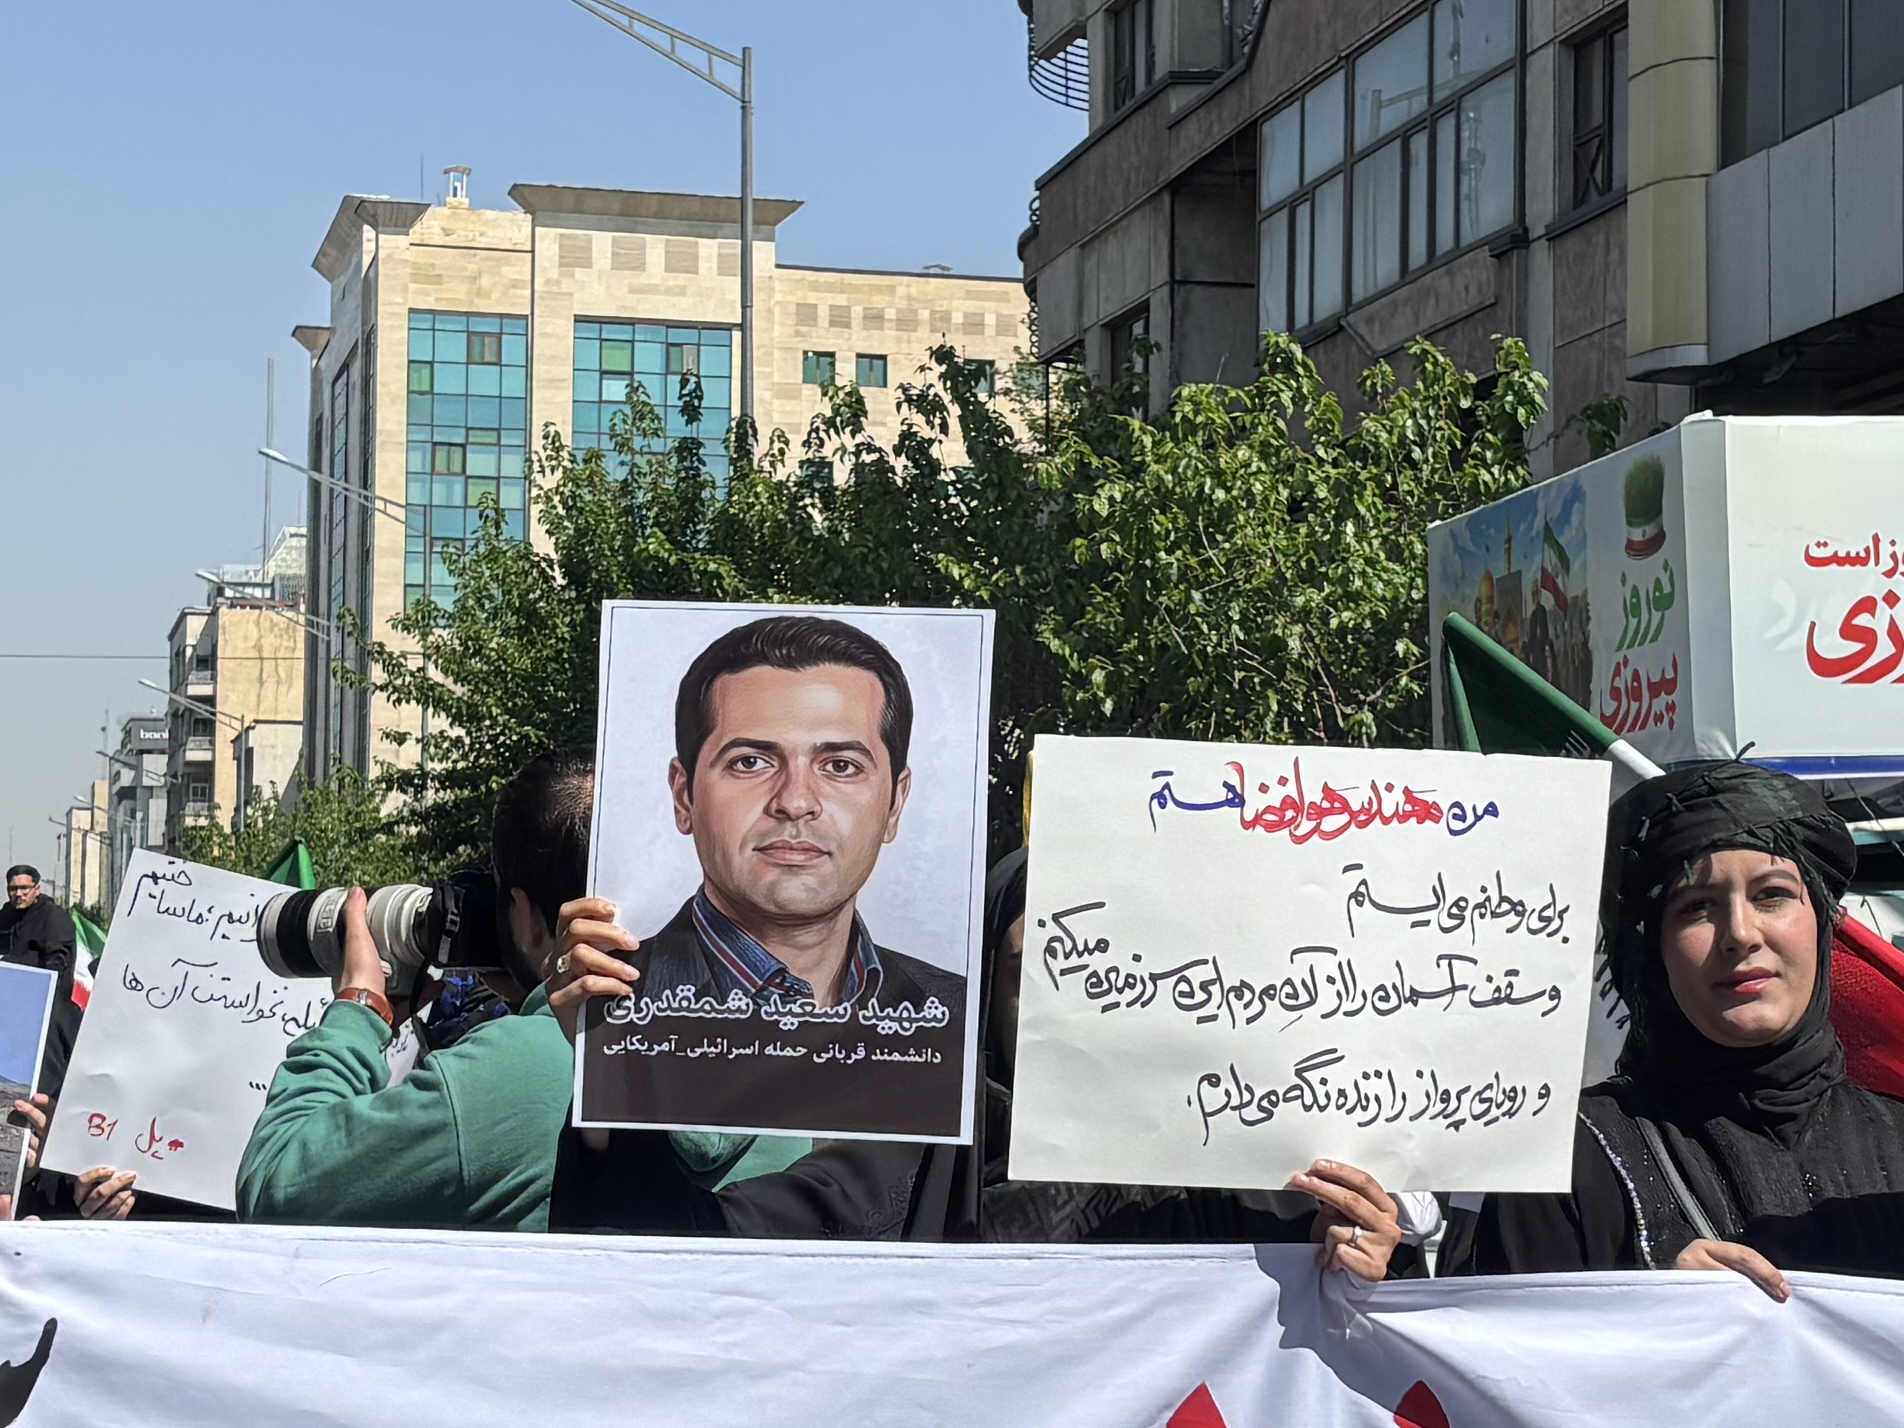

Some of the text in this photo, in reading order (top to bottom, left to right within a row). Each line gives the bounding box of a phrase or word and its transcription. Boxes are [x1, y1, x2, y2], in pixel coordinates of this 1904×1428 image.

[1803, 532, 1880, 568] است
[1615, 558, 1675, 652] نوروز
[1599, 652, 1679, 737] پیروزی
[1149, 770, 1246, 833] هستم
[1446, 800, 1500, 837] من
[1470, 869, 1527, 946] وطنم
[1526, 882, 1570, 945] برای
[604, 983, 949, 1035] شهید سعید شمقدری
[1085, 953, 1209, 1014] سرزمین
[1173, 955, 1225, 1024] این
[1225, 977, 1278, 1030] مردم
[1319, 960, 1349, 1019] از
[1342, 958, 1367, 1017] را
[1371, 953, 1479, 1016] آسمان
[1469, 968, 1547, 1009] سقف
[764, 1041, 808, 1060] حمله
[812, 1041, 866, 1064] قربانی
[870, 1045, 942, 1064] دانشمند
[1335, 1069, 1383, 1128] زنده
[1384, 1068, 1408, 1123] را
[1409, 1068, 1472, 1133] پرواز
[1470, 1071, 1527, 1128] رویای
[1532, 1082, 1552, 1117] و
[87, 1112, 118, 1141] B1
